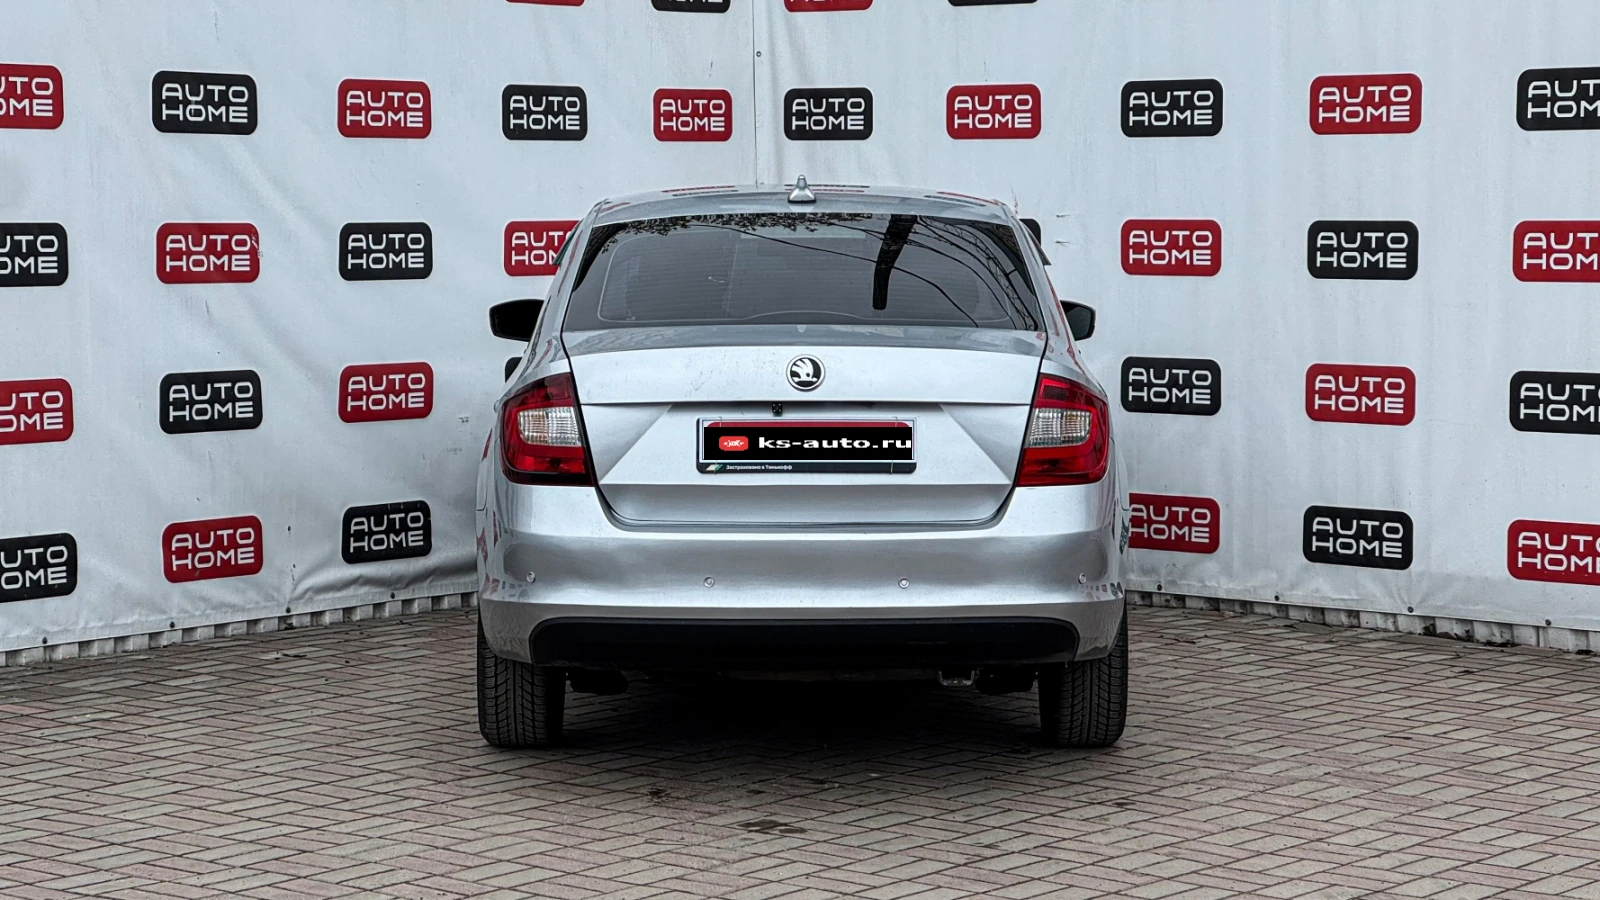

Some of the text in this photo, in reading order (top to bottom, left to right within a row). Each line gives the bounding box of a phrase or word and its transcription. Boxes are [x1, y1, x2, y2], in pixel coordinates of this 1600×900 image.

[0, 76, 53, 95] TO
[162, 83, 248, 103] AUTO
[1319, 85, 1412, 103] AUTO
[1528, 79, 1600, 98] AUT
[0, 98, 53, 116] ME
[346, 91, 423, 108] AUTO
[510, 95, 580, 112] AUTO
[660, 99, 725, 114] AUTO
[792, 98, 865, 113] AUTO
[954, 95, 1032, 111] AUTO
[1129, 90, 1214, 107] AUTO
[162, 103, 248, 123] HOME
[346, 110, 423, 127] HOME
[1129, 109, 1212, 126] HOME
[1319, 105, 1410, 123] HOME
[1527, 100, 1600, 119] HOM
[510, 114, 580, 130] HOME
[660, 117, 725, 131] HOME
[792, 115, 864, 130] HOME
[954, 113, 1032, 129] HOME
[166, 235, 250, 252] AUTO
[348, 233, 425, 250] AUTO
[512, 231, 572, 247] AUT
[1129, 230, 1212, 246] AUTO
[1317, 232, 1408, 248] AUTO
[1524, 233, 1599, 249] AUT
[166, 255, 250, 272] HOME
[348, 252, 424, 269] HOME
[1129, 249, 1211, 265] HOME
[1316, 251, 1407, 268] HOME
[1523, 253, 1598, 270] HOM
[348, 373, 425, 392] AUTO
[1129, 368, 1212, 385] AUTO
[1315, 375, 1405, 394] AUTO
[0, 391, 63, 411] UTO
[169, 382, 253, 402] AUTO
[1129, 386, 1211, 404] HOME
[1520, 383, 1600, 401] AUT
[347, 392, 424, 411] HOME
[1315, 394, 1404, 414] HOME
[169, 401, 253, 422] HOME
[1520, 403, 1600, 422] HOM
[0, 412, 63, 432] OME
[351, 512, 423, 533] AUTO
[1129, 504, 1211, 524] AUTO
[1128, 522, 1209, 542] HOME
[1313, 517, 1403, 538] AUTO
[172, 528, 254, 551] AUTO
[350, 530, 423, 552] HOME
[1312, 536, 1402, 558] HOME
[1518, 532, 1600, 553] AUT
[0, 546, 68, 568] UTO
[172, 547, 254, 571] HOME
[1518, 551, 1600, 573] HOM
[1, 566, 67, 589] OME
